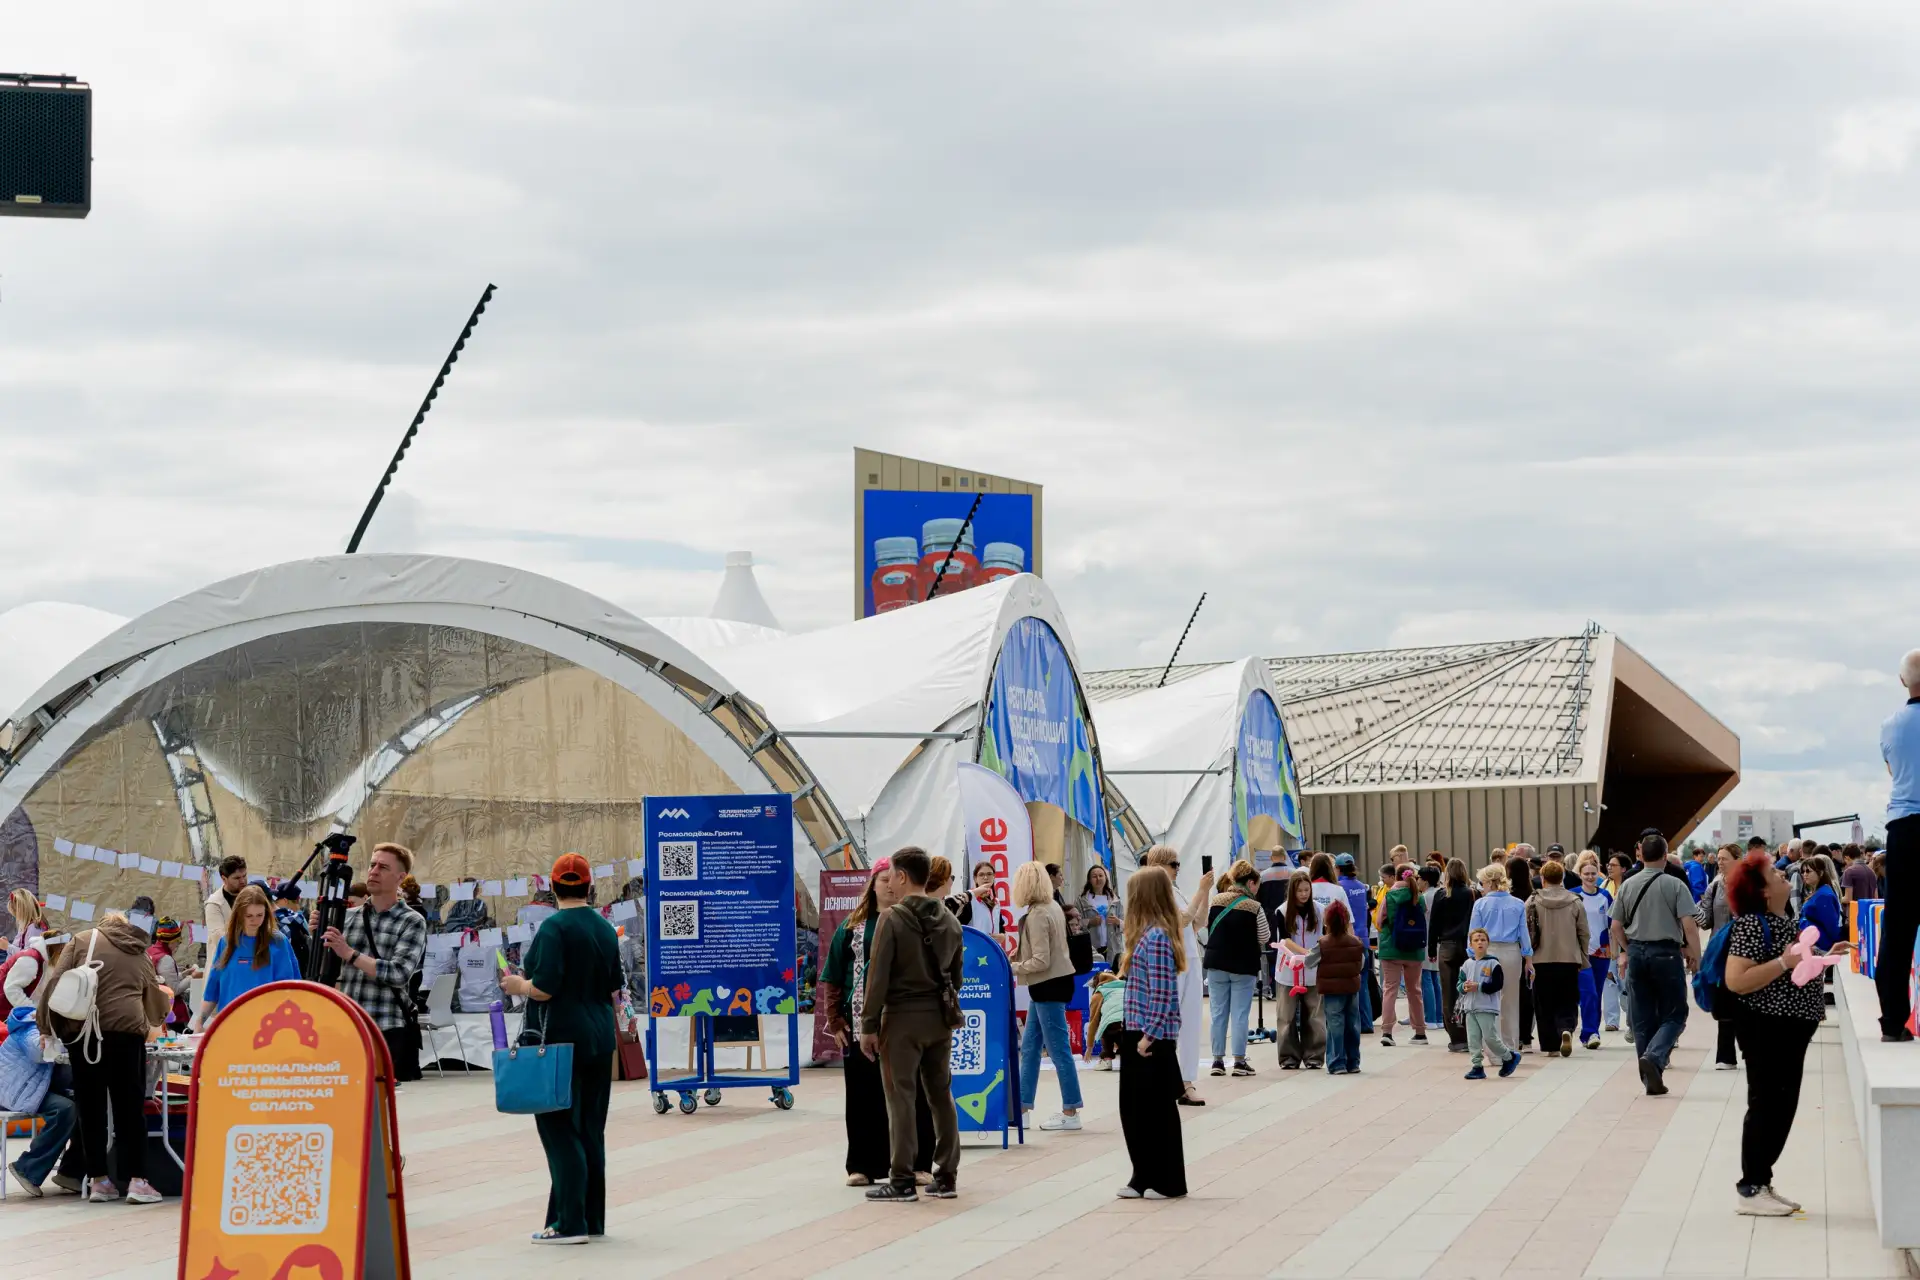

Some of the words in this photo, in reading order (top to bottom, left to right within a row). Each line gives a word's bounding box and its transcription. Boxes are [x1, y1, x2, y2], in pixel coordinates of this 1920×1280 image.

[658, 830, 743, 838] Росмолодёжь.Гранты
[659, 889, 749, 897] Росмолодёжь.Форумы
[228, 1060, 341, 1073] РЕГИОНАЛЬНЫЙ
[217, 1076, 258, 1087] ШТАБ
[260, 1075, 349, 1086] #МЫВМЕСТЕ
[231, 1088, 334, 1099] ЧЕЛЯБИНСКАЯ
[249, 1101, 315, 1112] ОБЛАСТЬ
